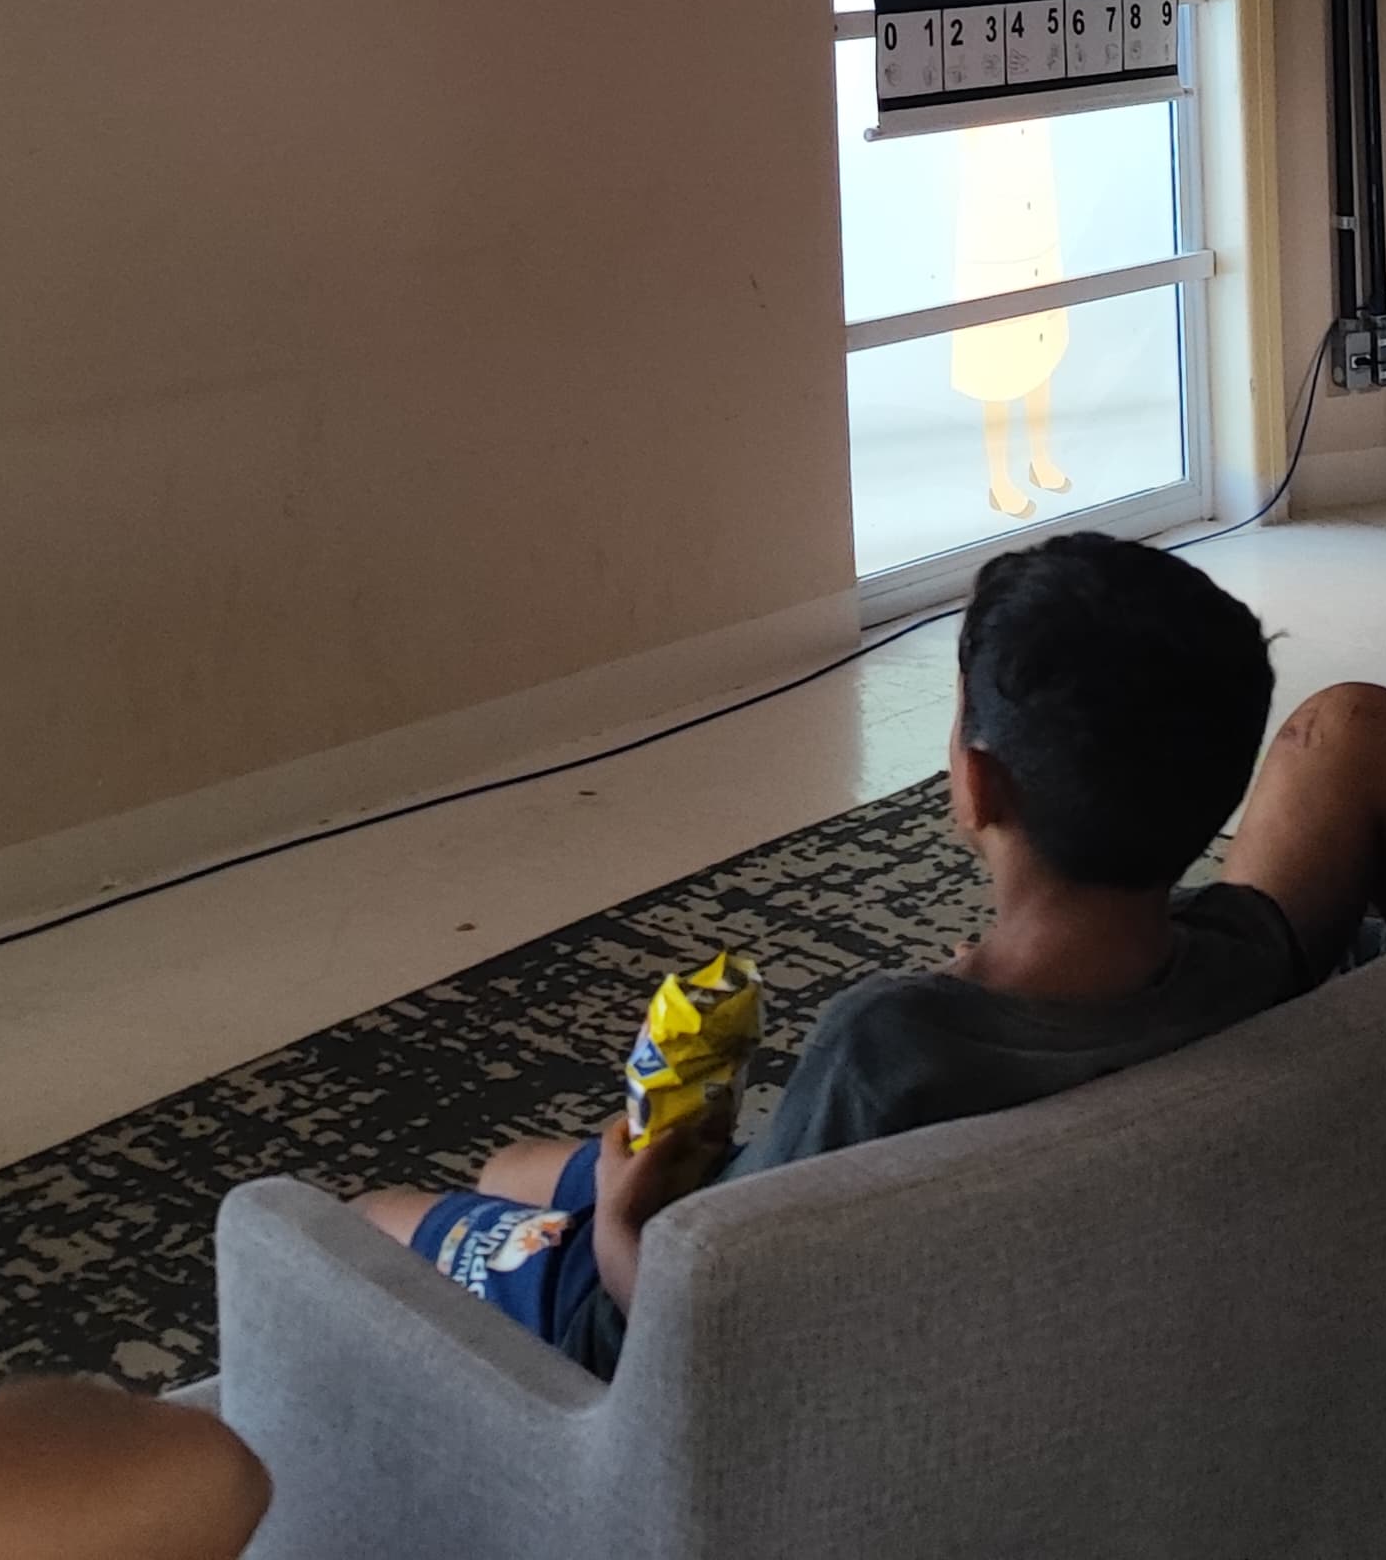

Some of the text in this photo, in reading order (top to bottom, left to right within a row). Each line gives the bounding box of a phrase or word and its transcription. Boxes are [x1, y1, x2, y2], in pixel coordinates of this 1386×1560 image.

[884, 1, 1172, 51] 0 1 2 3 4 5 6 7 8 9
